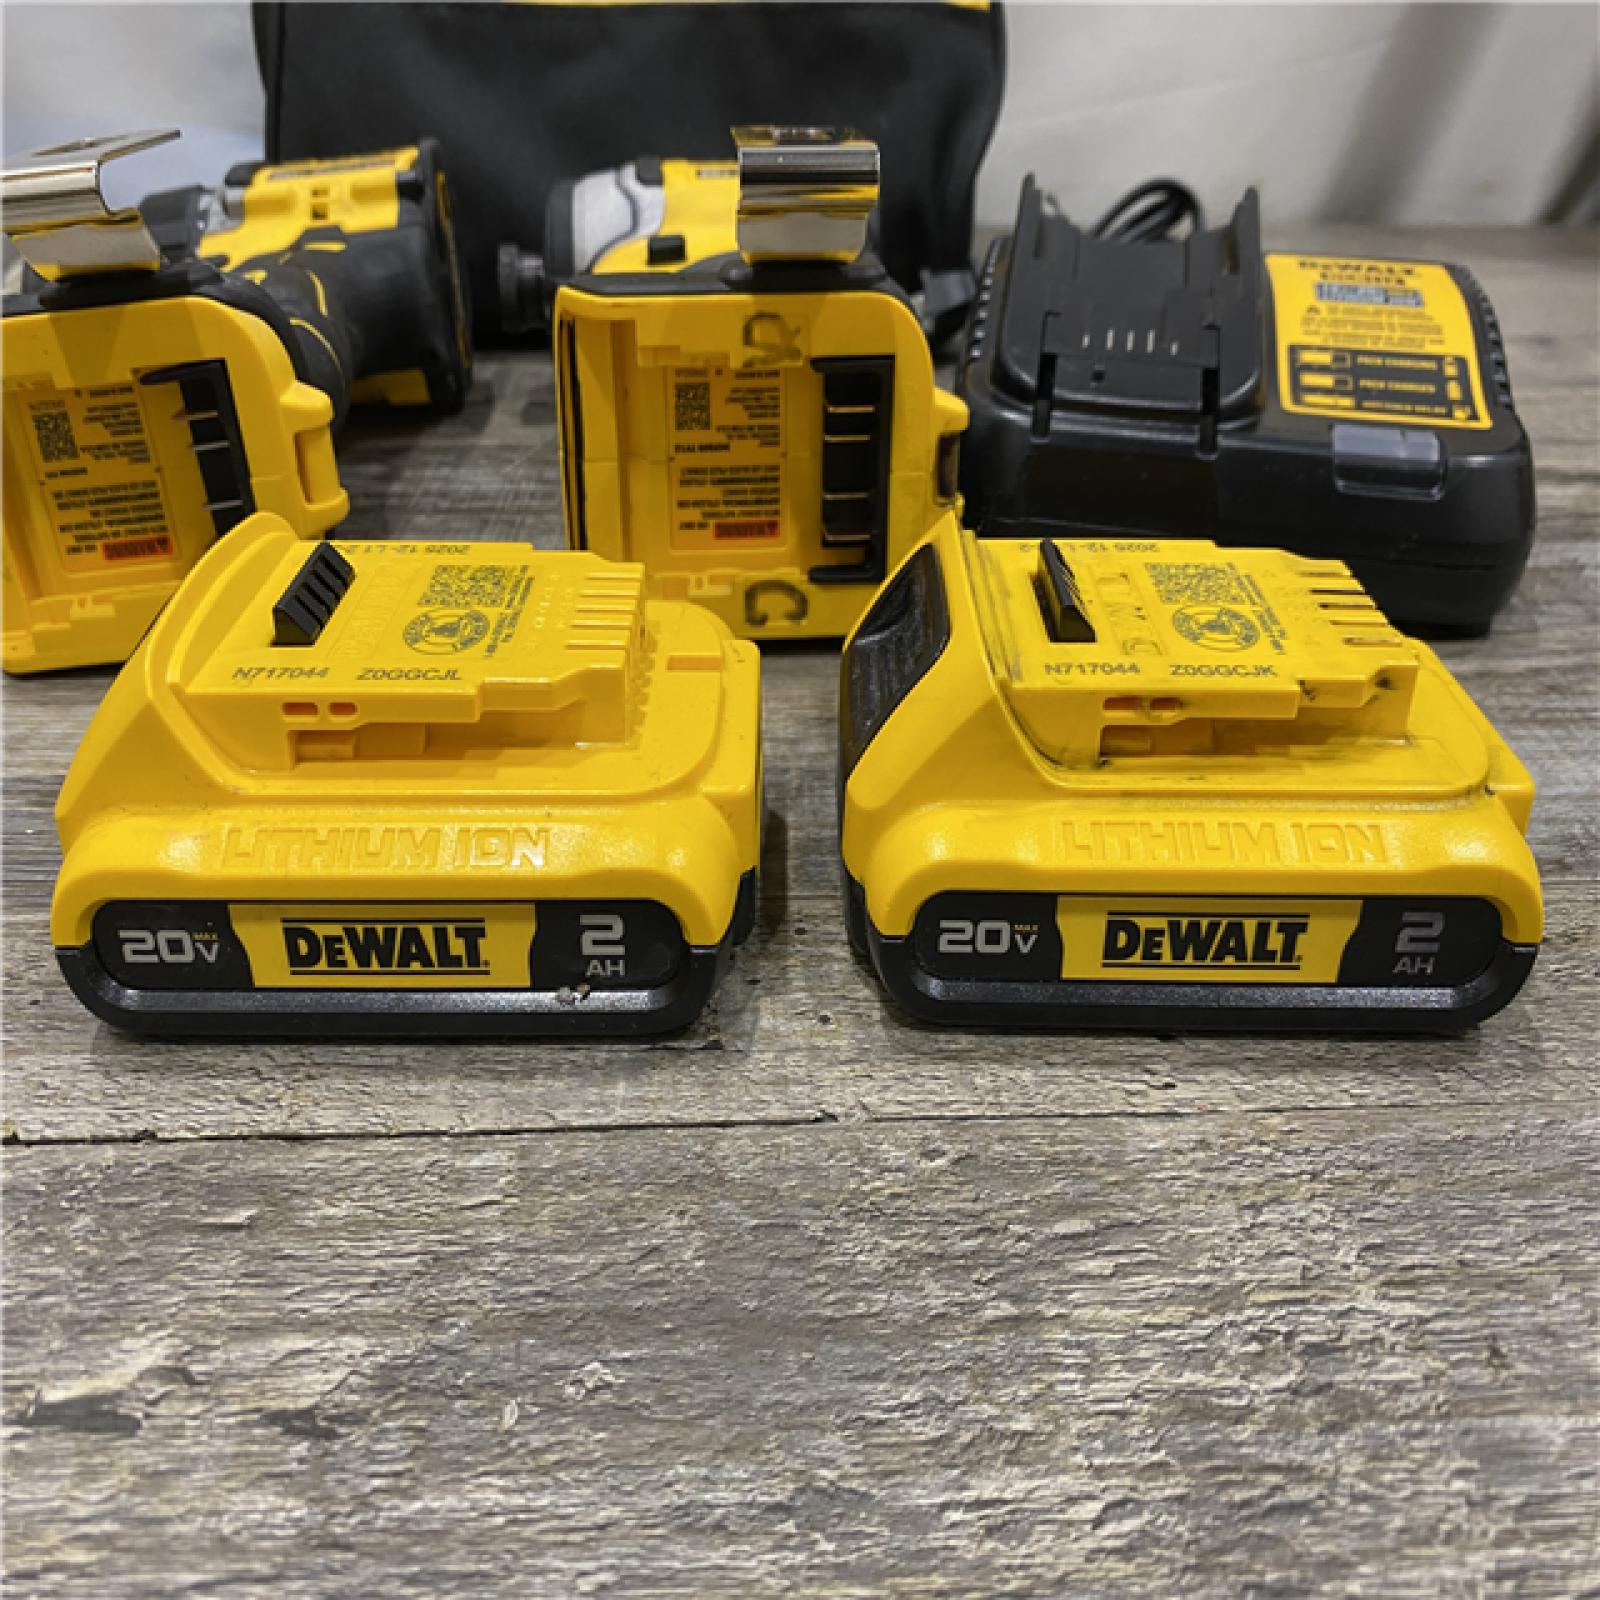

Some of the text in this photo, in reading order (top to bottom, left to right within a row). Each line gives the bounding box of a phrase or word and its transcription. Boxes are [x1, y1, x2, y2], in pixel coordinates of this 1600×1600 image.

[222, 825, 550, 867] LITHIUM ION
[1061, 820, 1389, 864] LITHIUM ION
[283, 926, 486, 968] DEWALT
[579, 914, 626, 956] 2
[1104, 919, 1308, 963] DEWALT
[1394, 911, 1446, 953] 2
[584, 959, 626, 977] AH
[1391, 956, 1436, 975] AH
